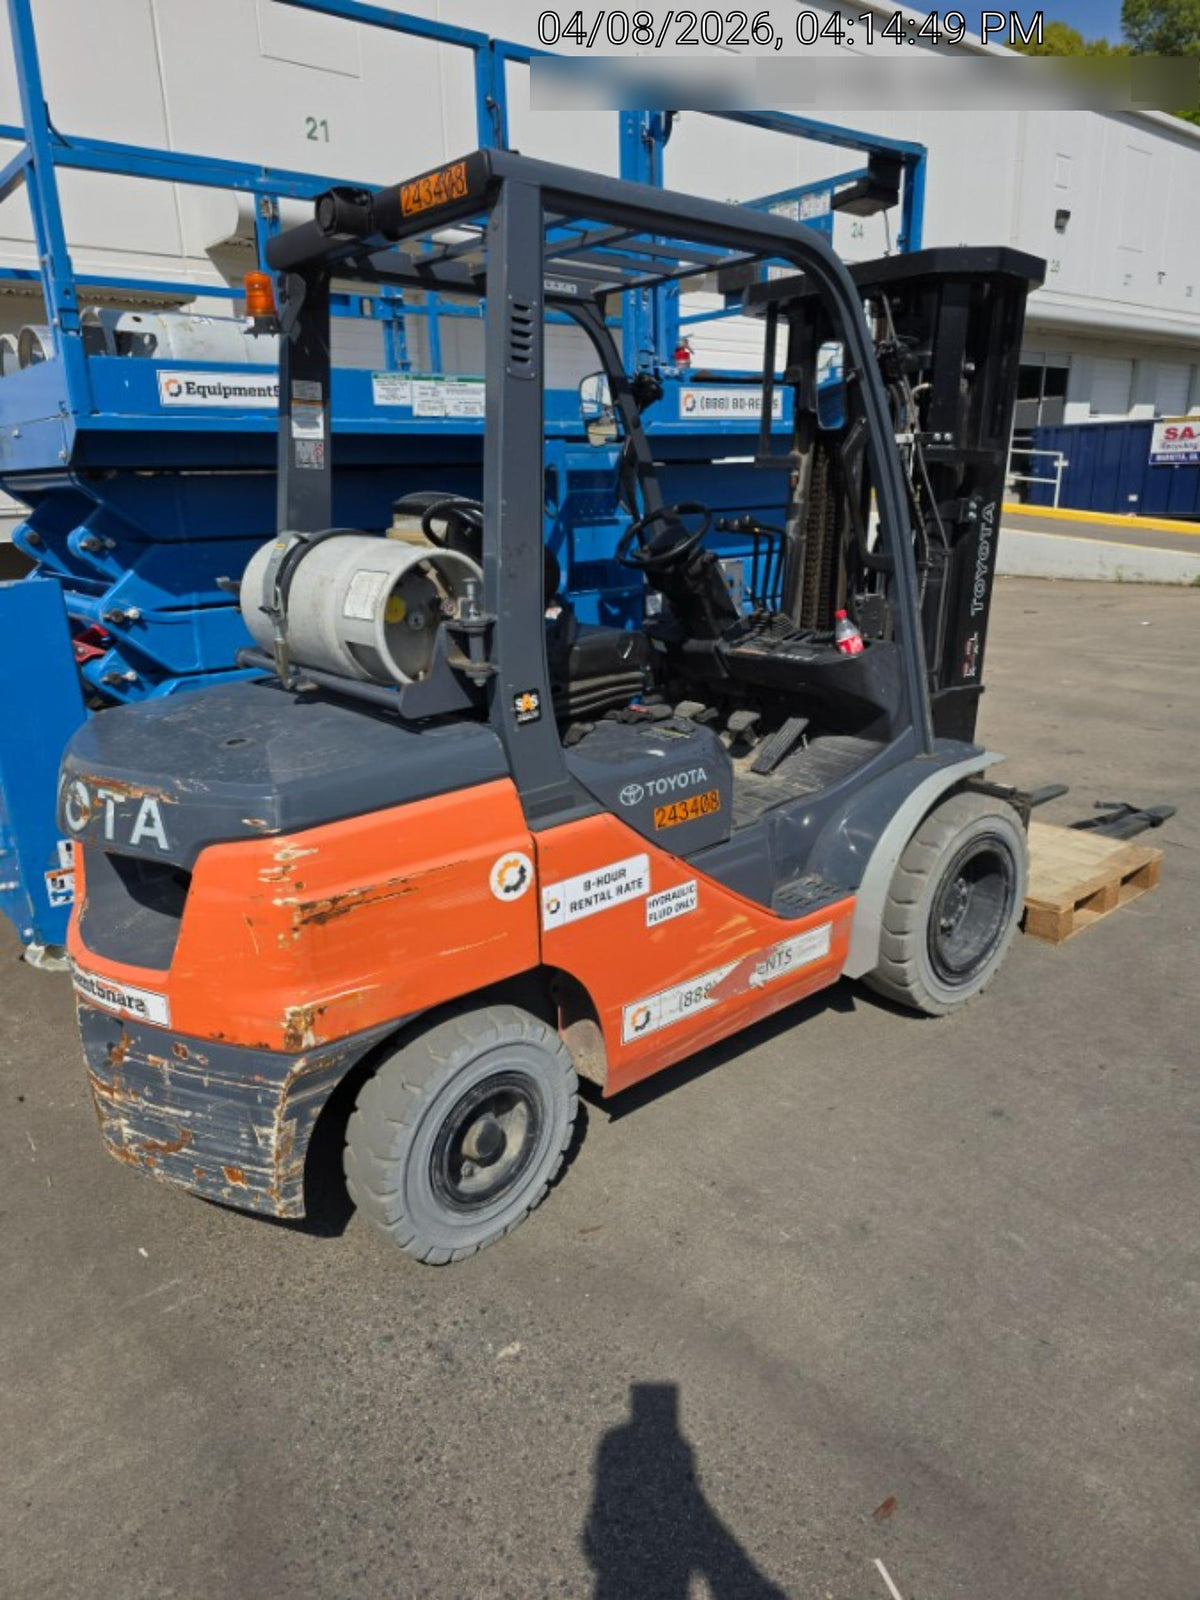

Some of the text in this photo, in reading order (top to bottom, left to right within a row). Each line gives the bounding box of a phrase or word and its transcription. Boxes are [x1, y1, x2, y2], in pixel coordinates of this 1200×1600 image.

[305, 116, 330, 143] 21
[971, 501, 996, 616] TOYOTA
[645, 767, 708, 796] TOYOTA
[60, 774, 170, 851] OTA
[655, 790, 720, 828] 243408
[583, 868, 627, 892] 8-HOUR
[569, 877, 644, 913] RENTAL RATE
[648, 884, 696, 909] HYDRAULIC
[648, 898, 696, 923] FLUID ONLY
